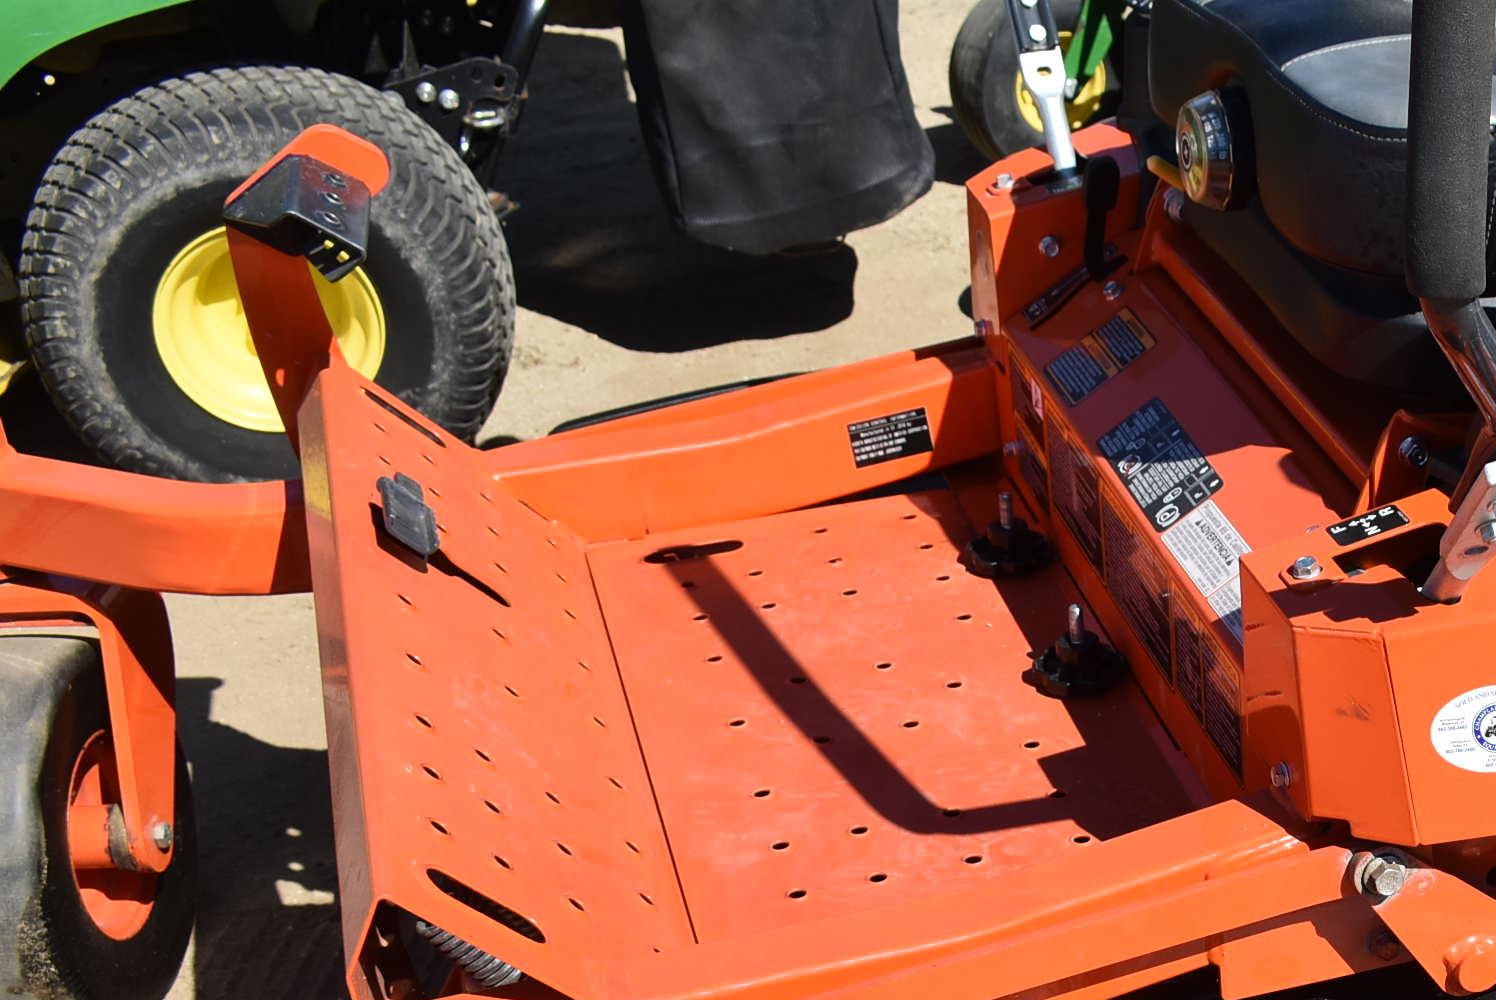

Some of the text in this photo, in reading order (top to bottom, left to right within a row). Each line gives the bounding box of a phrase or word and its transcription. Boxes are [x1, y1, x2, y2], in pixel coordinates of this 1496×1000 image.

[1378, 506, 1396, 517] R
[1330, 526, 1348, 535] F
[1364, 525, 1382, 536] N
